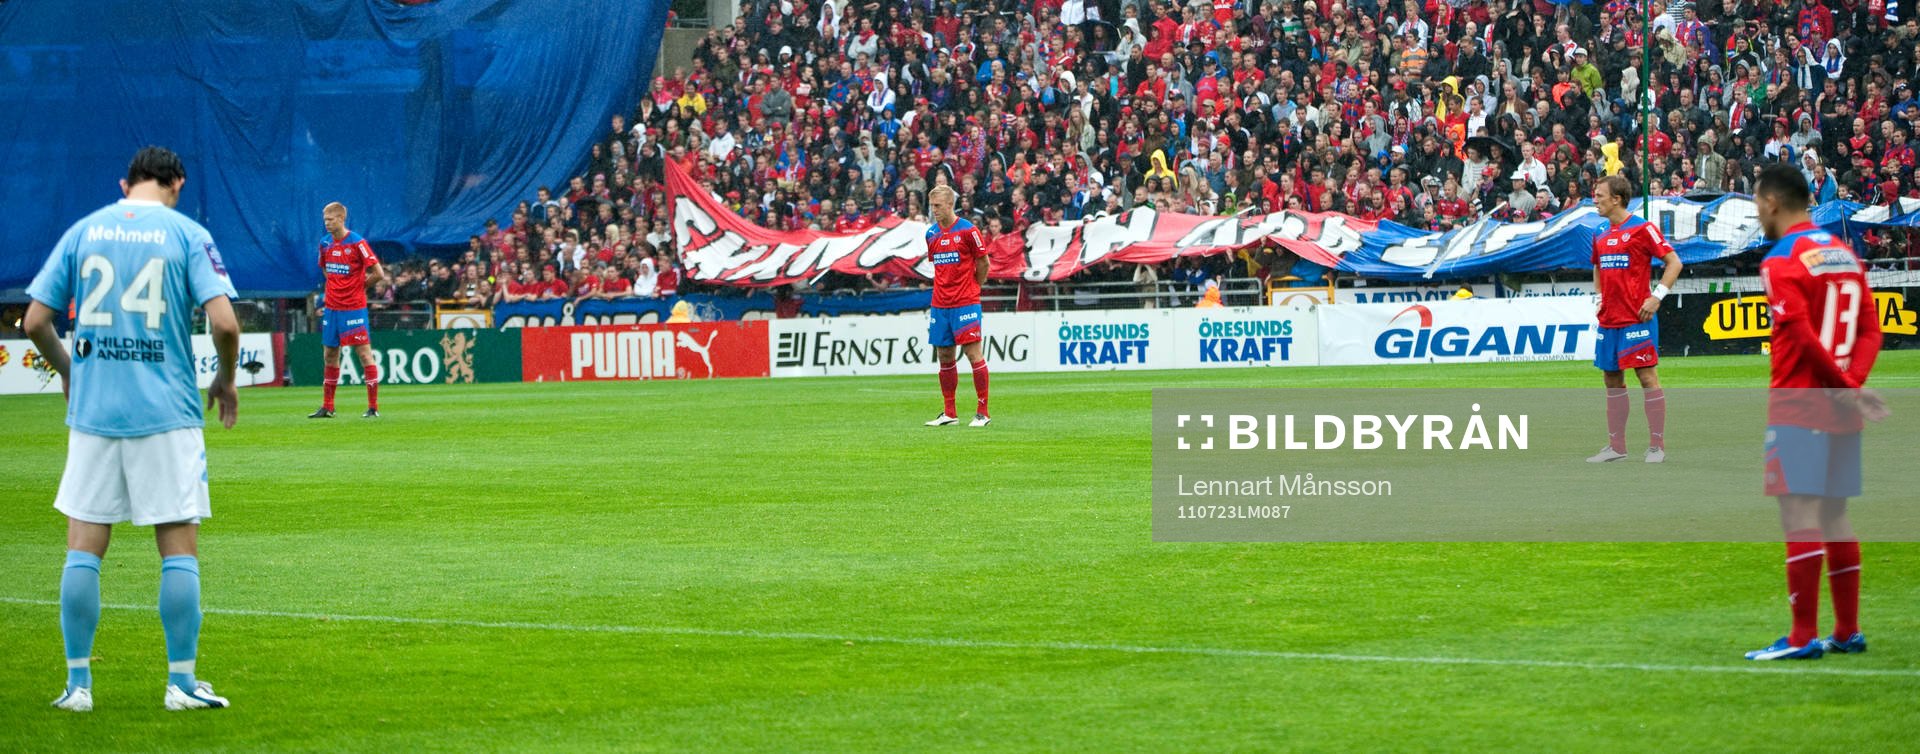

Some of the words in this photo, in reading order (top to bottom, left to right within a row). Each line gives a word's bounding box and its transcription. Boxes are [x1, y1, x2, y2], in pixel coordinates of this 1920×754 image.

[87, 224, 167, 245] Mehmeti
[79, 254, 166, 329] 24
[959, 312, 978, 322] SOLID
[1199, 318, 1293, 337] ÖRESUNDS
[1819, 279, 1862, 358] 13
[1059, 322, 1150, 341] ÖRESUNDS
[1374, 320, 1590, 359] GIGANT
[1625, 329, 1650, 340] SOLID
[97, 336, 165, 350] HILDING
[813, 331, 899, 367] ERNST
[903, 336, 923, 365] &
[1059, 340, 1150, 365] KRAFT
[1200, 338, 1293, 362] KRAFT
[97, 350, 165, 363] ANDERS
[570, 330, 676, 379] PUMA
